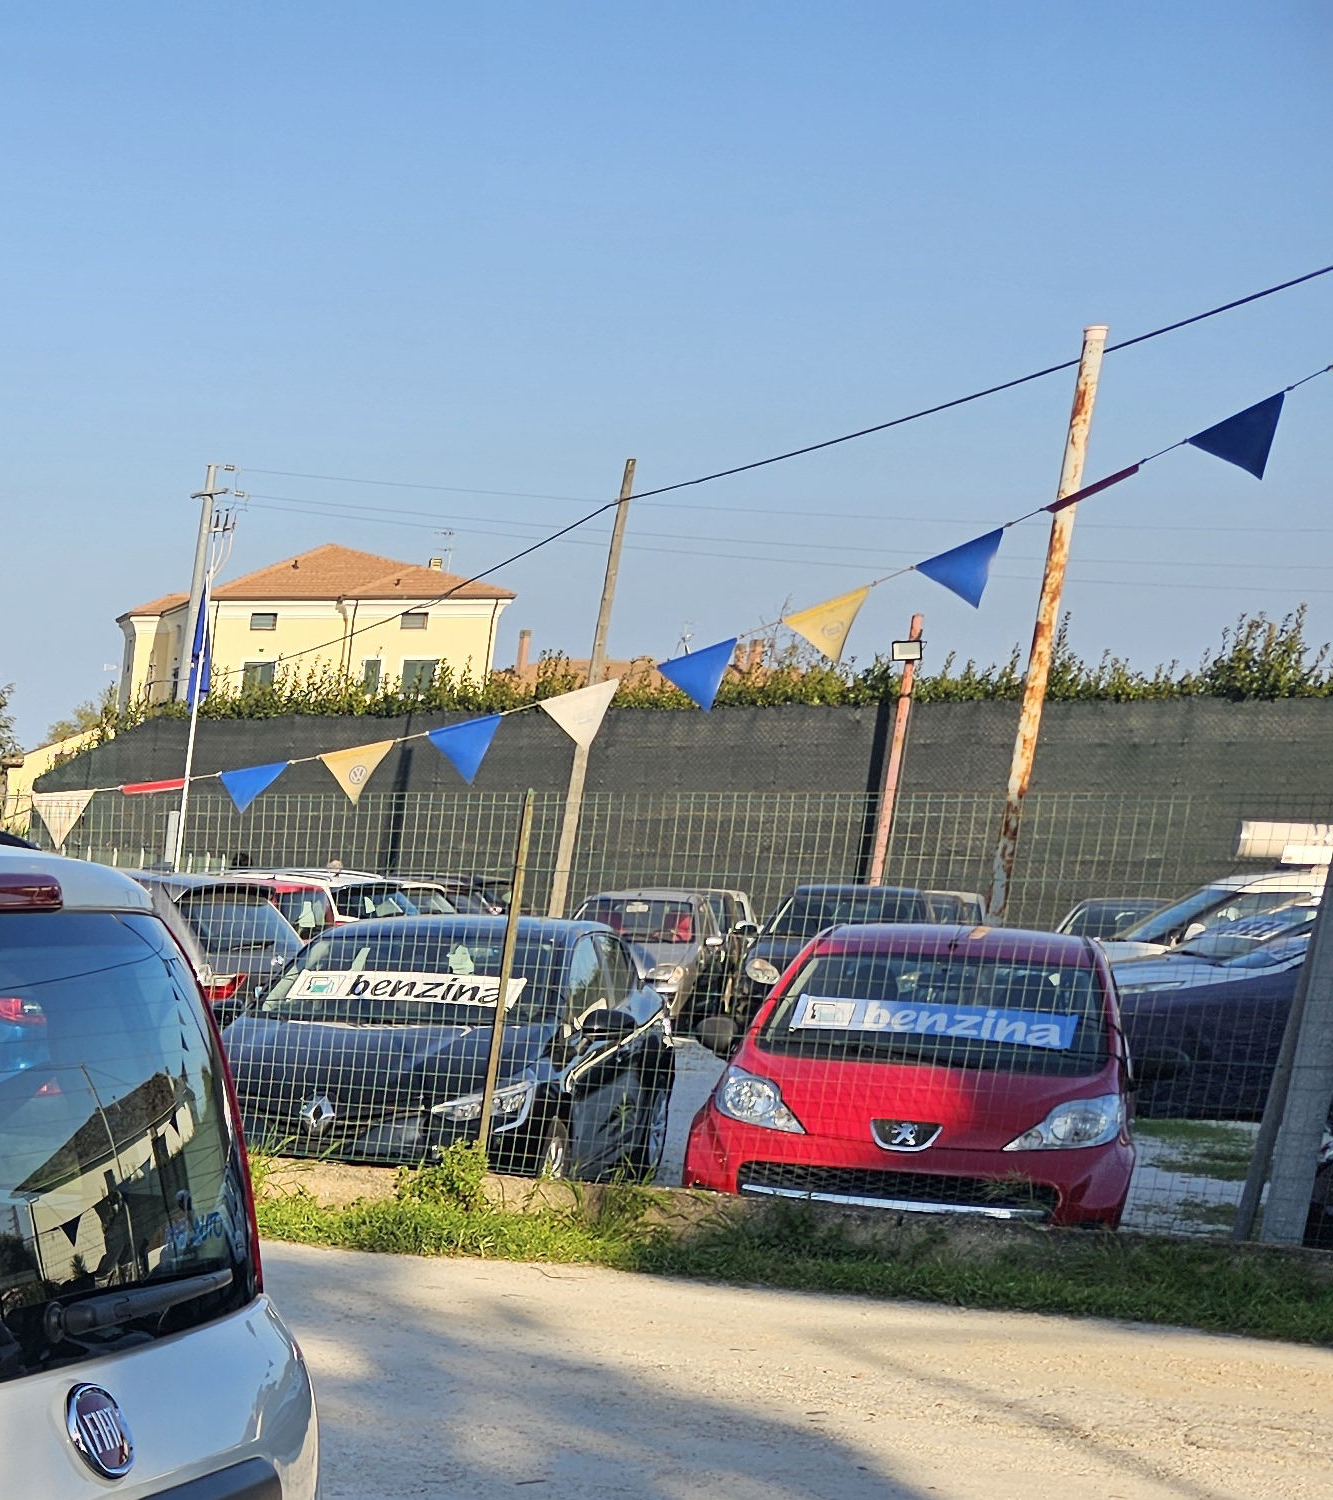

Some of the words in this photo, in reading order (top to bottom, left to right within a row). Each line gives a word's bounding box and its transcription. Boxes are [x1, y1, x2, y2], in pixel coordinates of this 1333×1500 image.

[346, 974, 502, 1006] benzina
[860, 1001, 1062, 1047] benzina
[82, 1406, 123, 1454] FIAT
